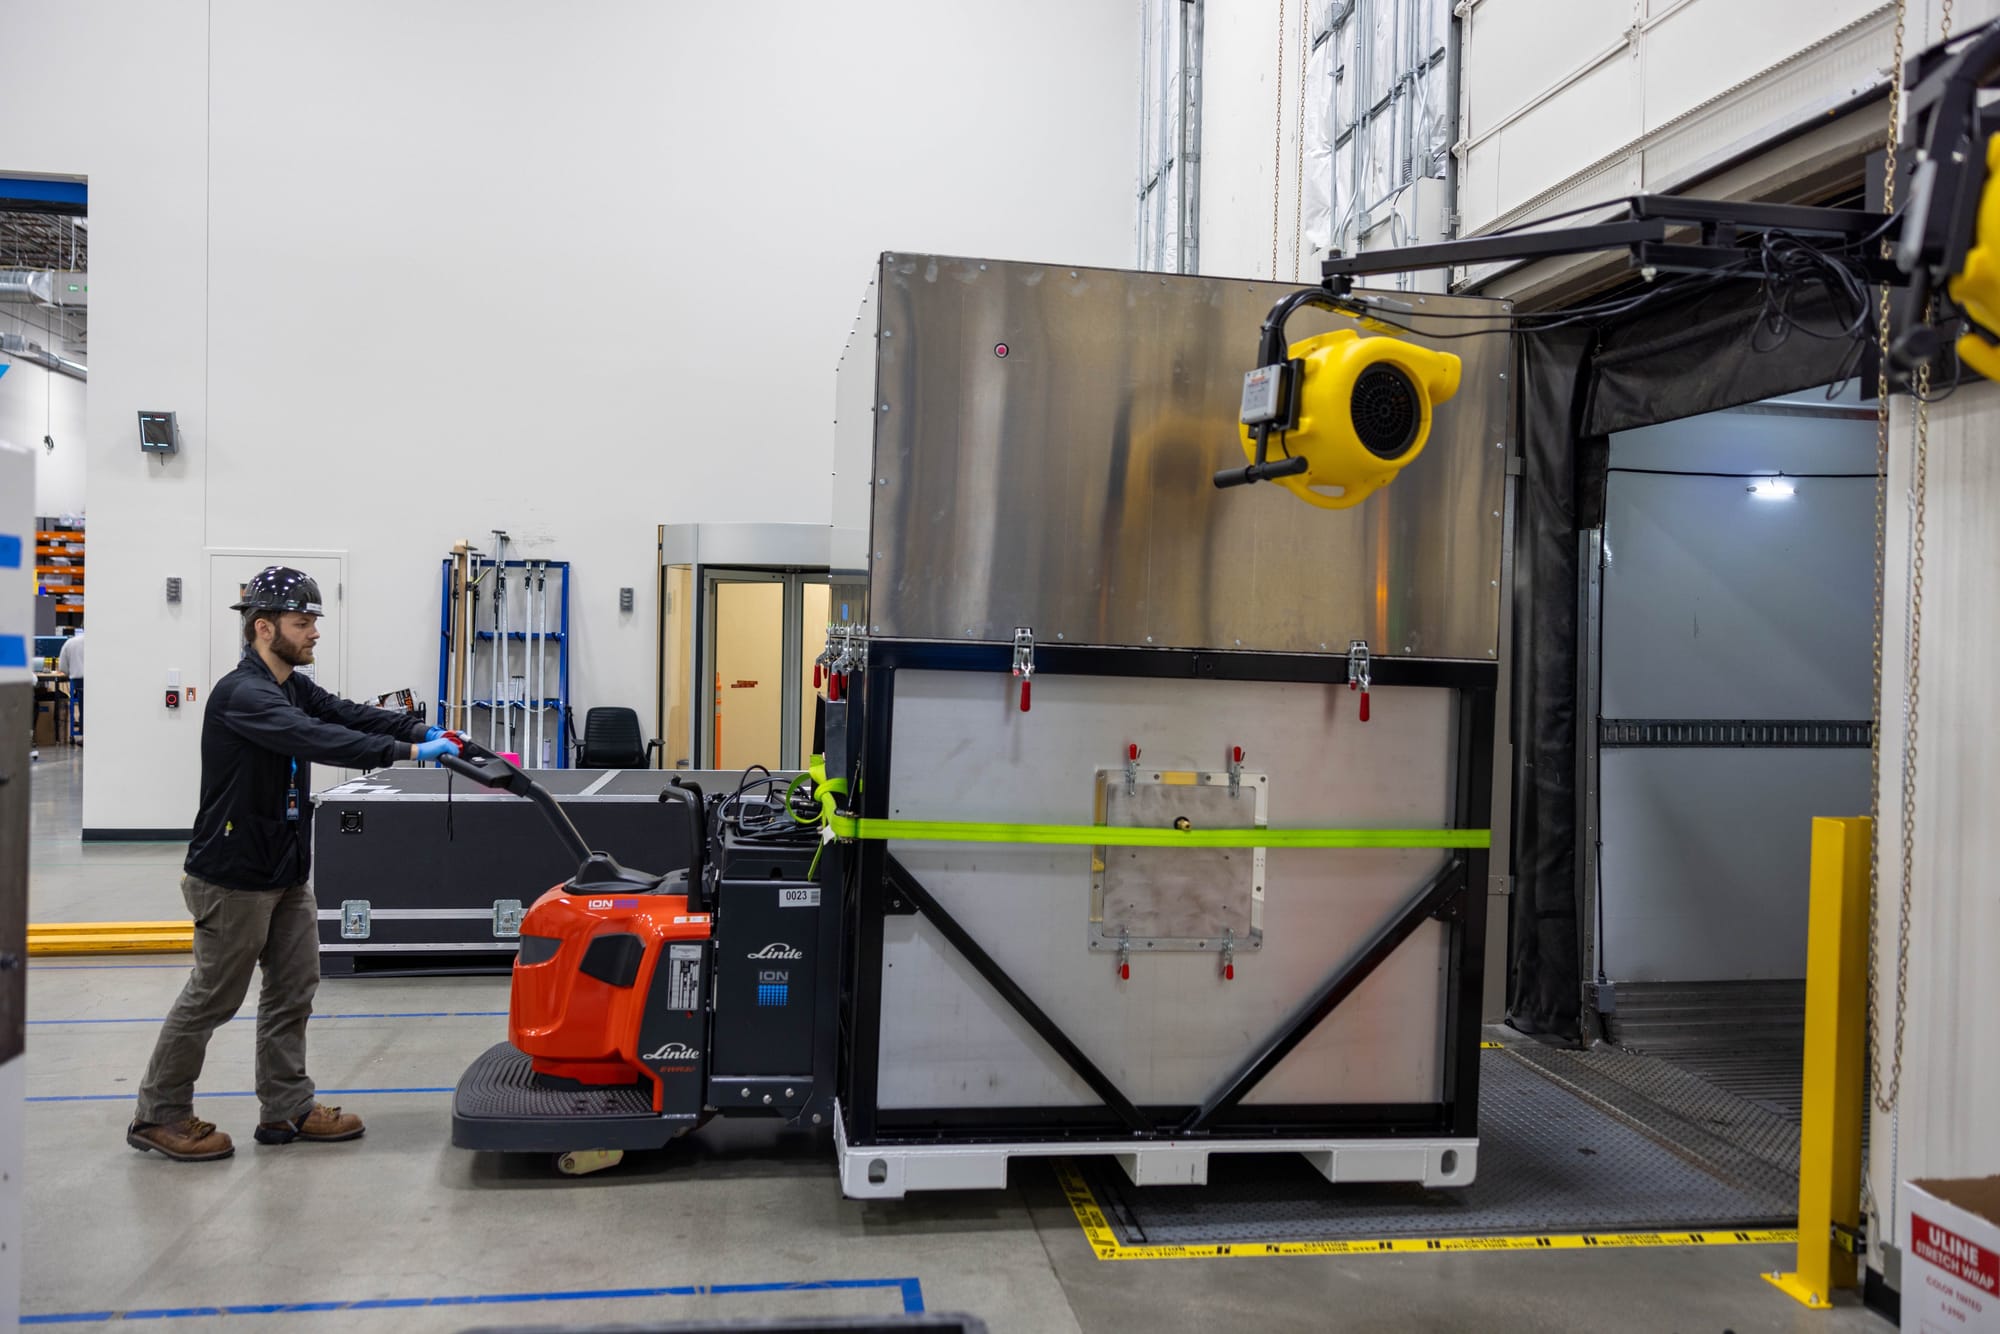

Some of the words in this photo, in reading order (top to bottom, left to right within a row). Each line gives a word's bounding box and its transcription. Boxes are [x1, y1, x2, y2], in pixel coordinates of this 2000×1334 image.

[588, 899, 613, 909] ION
[786, 890, 808, 901] 0023
[747, 942, 803, 960] Linde
[759, 970, 789, 981] ION
[642, 1042, 700, 1060] Linde
[1928, 1225, 1979, 1267] ULINE
[1915, 1239, 1960, 1273] STRETCH
[1962, 1263, 1995, 1289] WRAP
